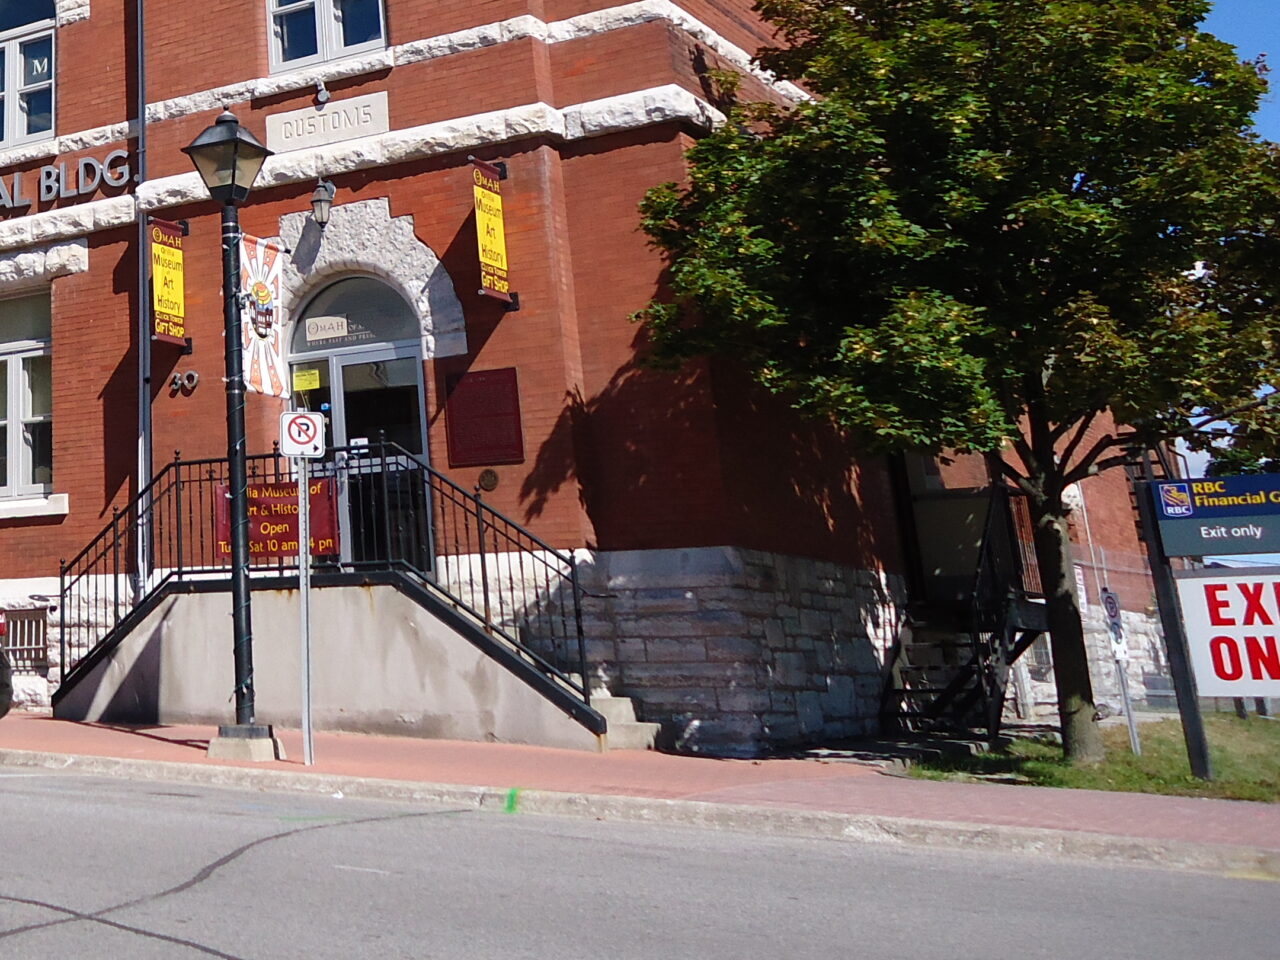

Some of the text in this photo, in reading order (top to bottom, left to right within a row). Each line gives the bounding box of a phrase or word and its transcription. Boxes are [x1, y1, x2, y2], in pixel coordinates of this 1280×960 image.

[31, 57, 48, 76] M
[282, 104, 373, 140] CUSTOMS
[40, 149, 140, 202] BLDG.
[475, 197, 502, 218] Museum
[486, 222, 496, 239] Art
[153, 252, 183, 272] Museum
[481, 243, 504, 268] History
[163, 276, 174, 290] Art
[157, 295, 181, 315] History
[169, 322, 185, 338] SHOP
[261, 486, 301, 498] Museu
[309, 482, 322, 494] of
[1191, 481, 1226, 494] RBC
[1194, 491, 1266, 507] Financial
[260, 503, 270, 516] &
[271, 502, 310, 516] Histo
[1166, 505, 1190, 515] RBC
[260, 522, 290, 536] Open
[1200, 524, 1263, 540] Exit only
[218, 540, 231, 553] Tu
[249, 540, 264, 553] Sat
[267, 539, 279, 552] 10
[281, 540, 298, 552] am
